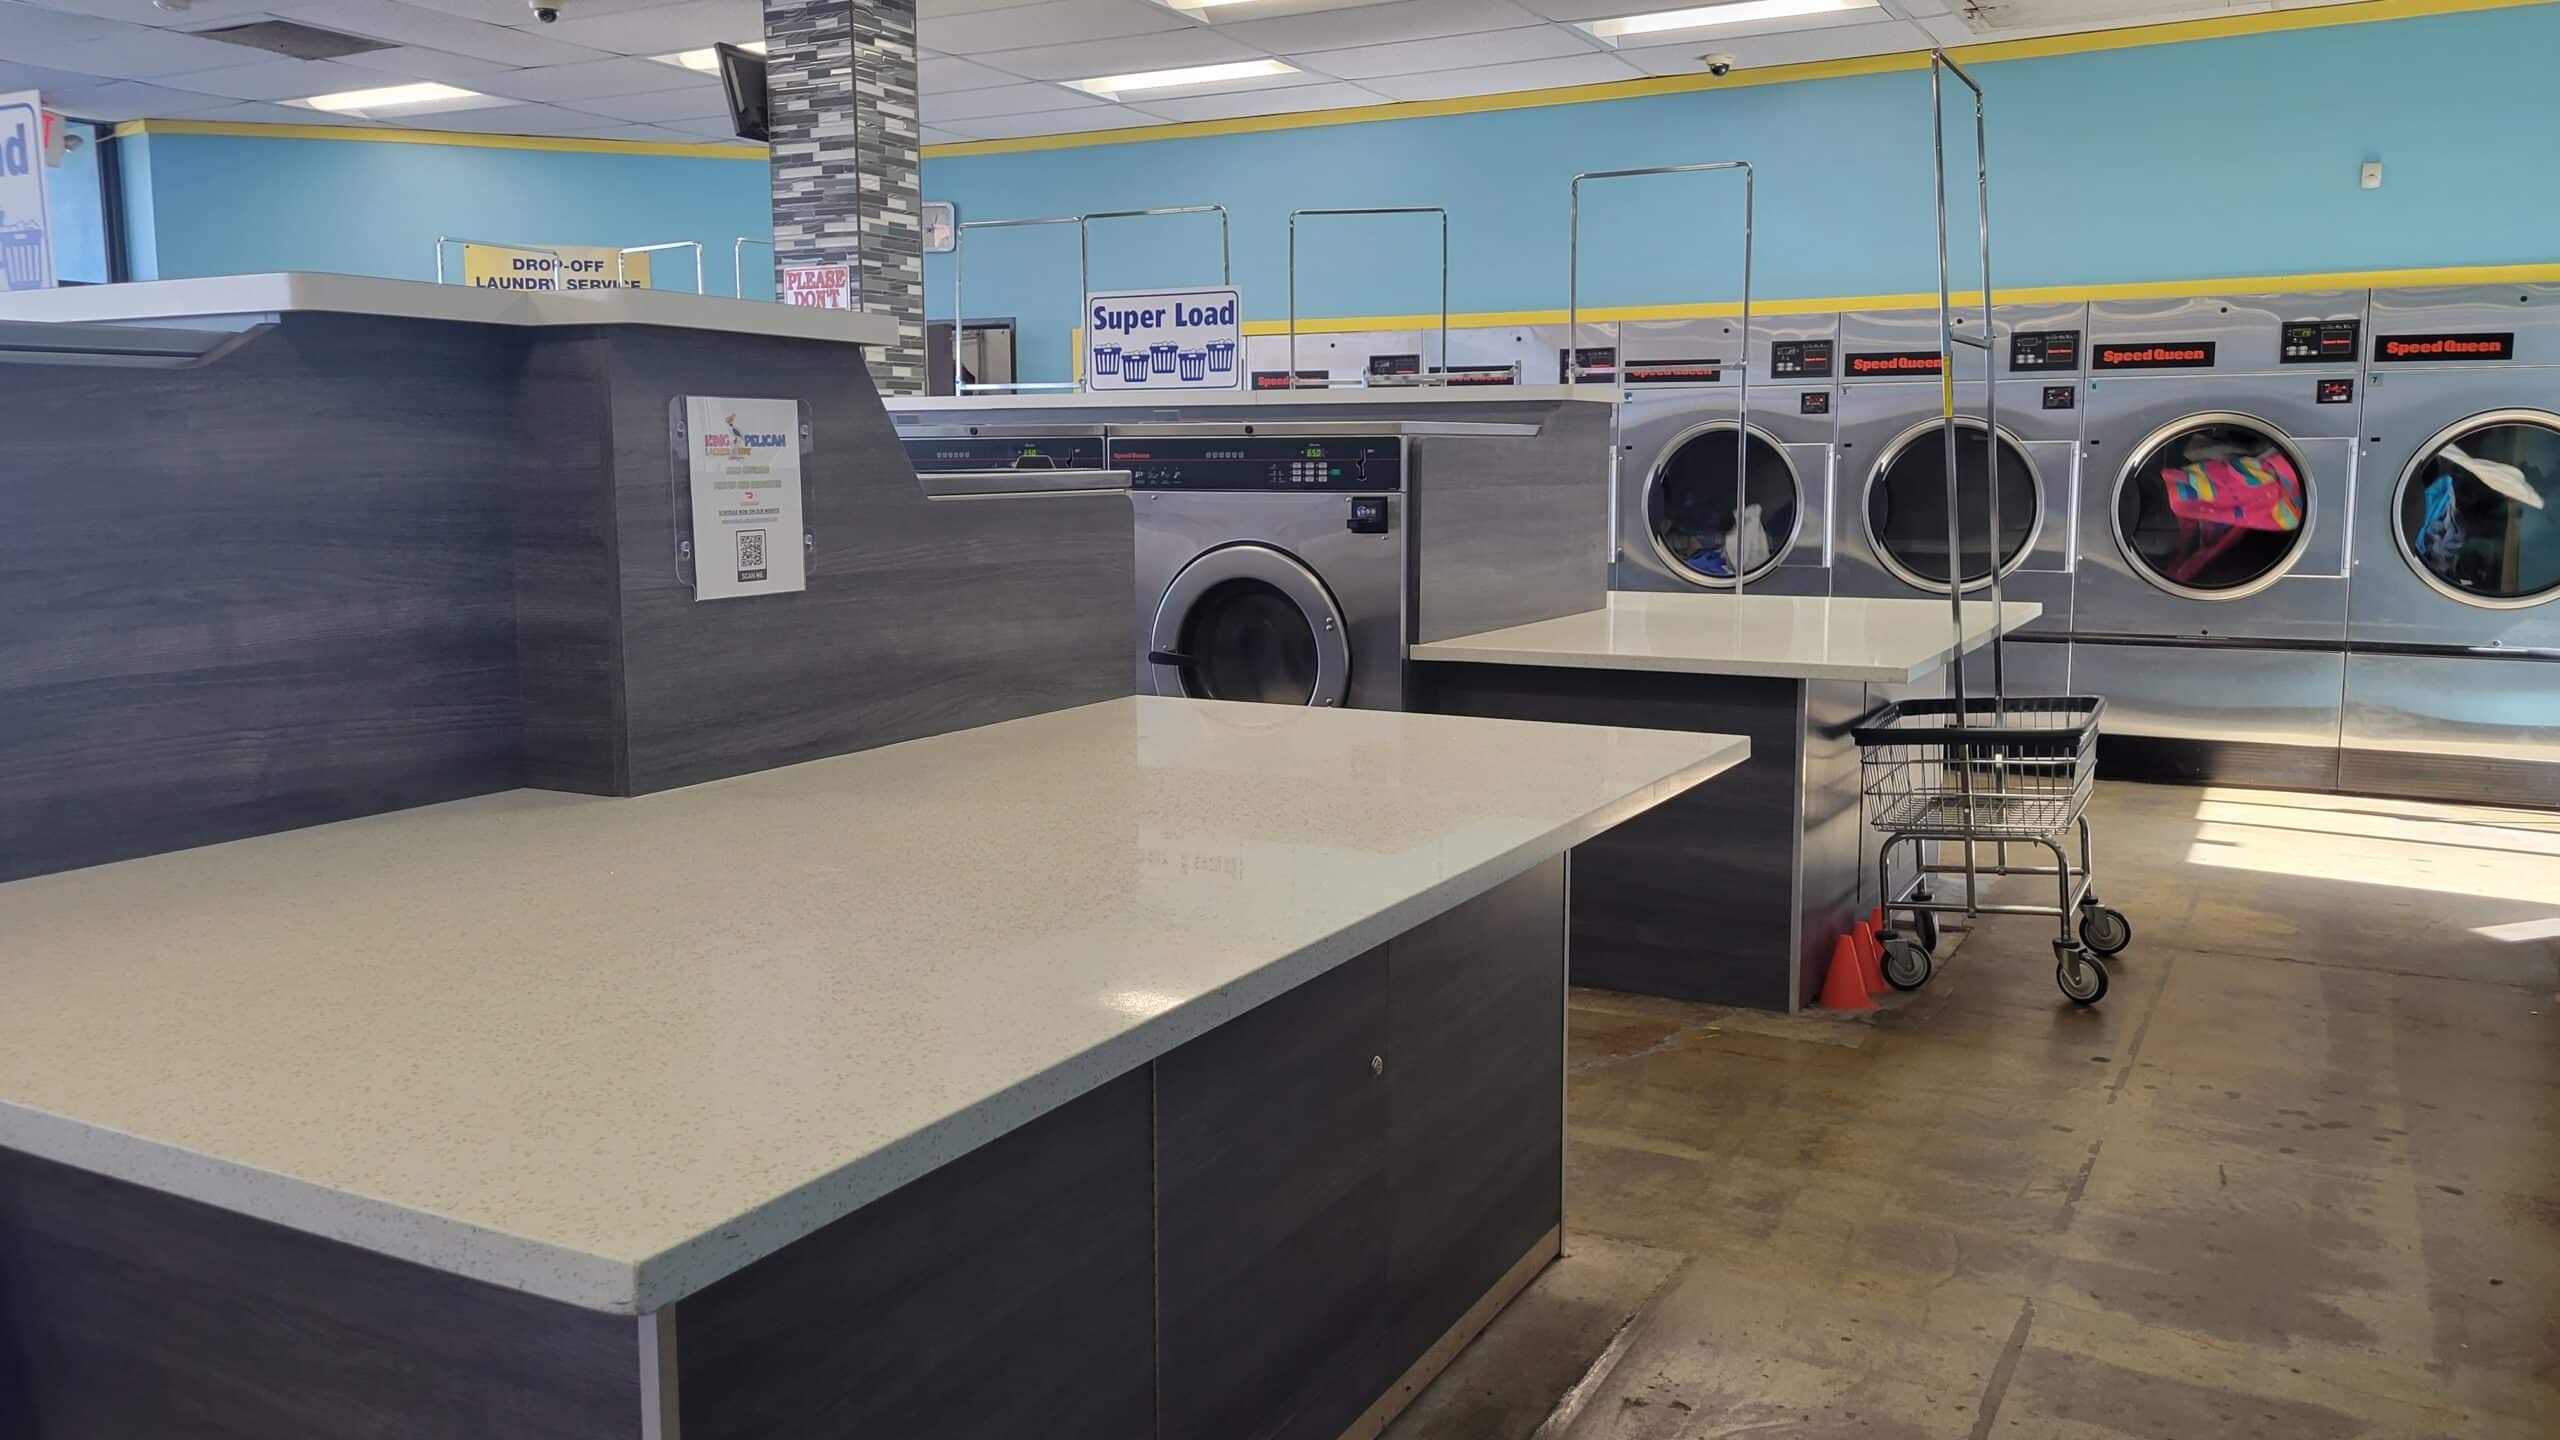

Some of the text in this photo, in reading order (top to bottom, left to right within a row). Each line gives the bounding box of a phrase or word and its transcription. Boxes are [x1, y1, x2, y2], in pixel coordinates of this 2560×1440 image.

[786, 269, 845, 290] PLEASE
[794, 289, 840, 308] DON'T
[1093, 300, 1235, 335] Super Load
[2103, 347, 2205, 364] Speed Queen
[2386, 339, 2502, 356] Speed Queen
[1854, 357, 1942, 371] Speed Queen
[744, 433, 786, 447] PELICAN
